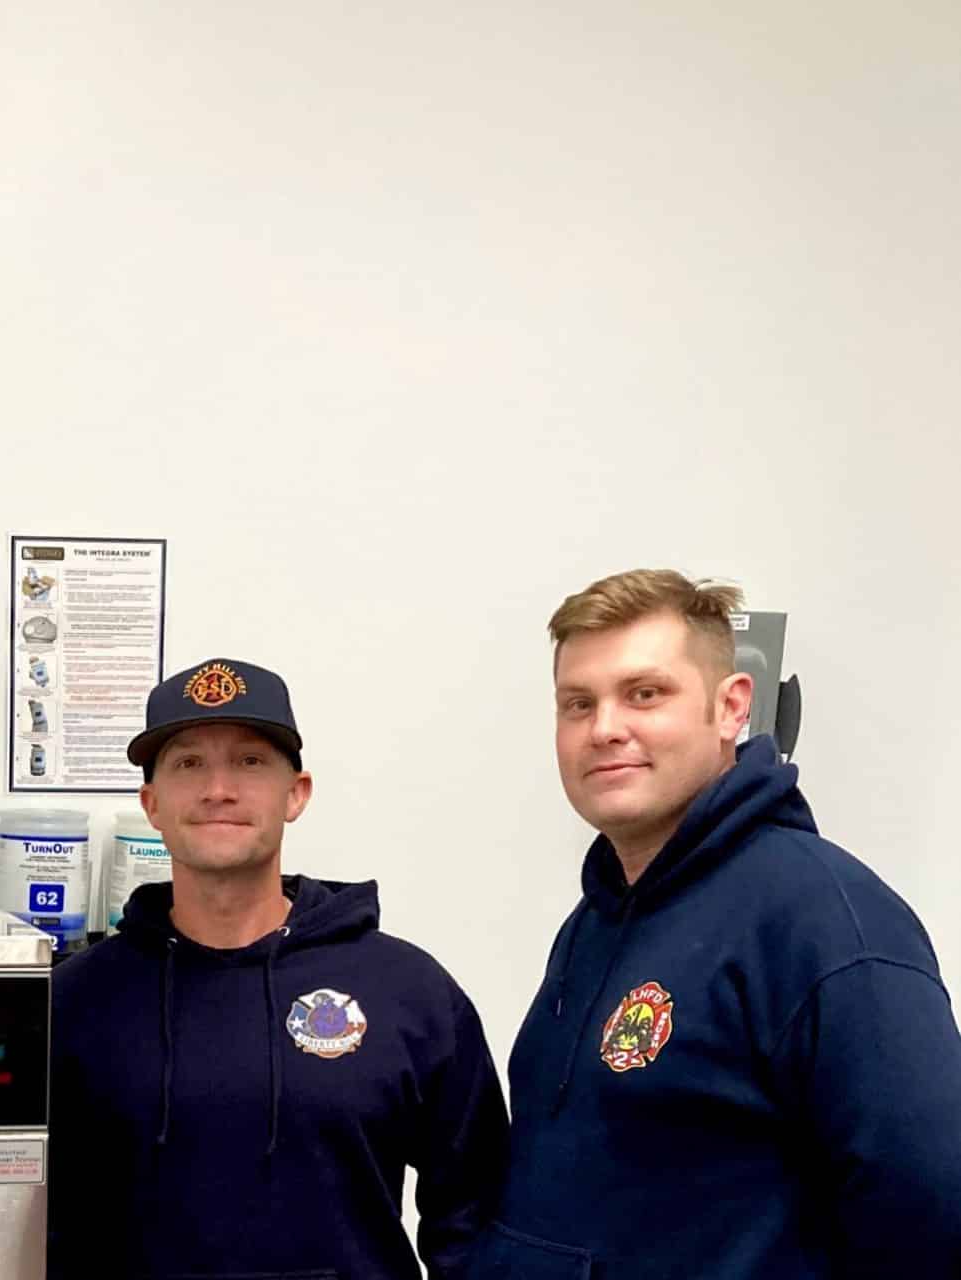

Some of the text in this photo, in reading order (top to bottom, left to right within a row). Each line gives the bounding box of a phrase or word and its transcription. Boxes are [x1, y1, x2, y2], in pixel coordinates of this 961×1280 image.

[22, 841, 75, 854] TURNOUT
[129, 844, 171, 857] LAUNDR
[36, 891, 59, 906] 62
[632, 987, 664, 1004] LHFD
